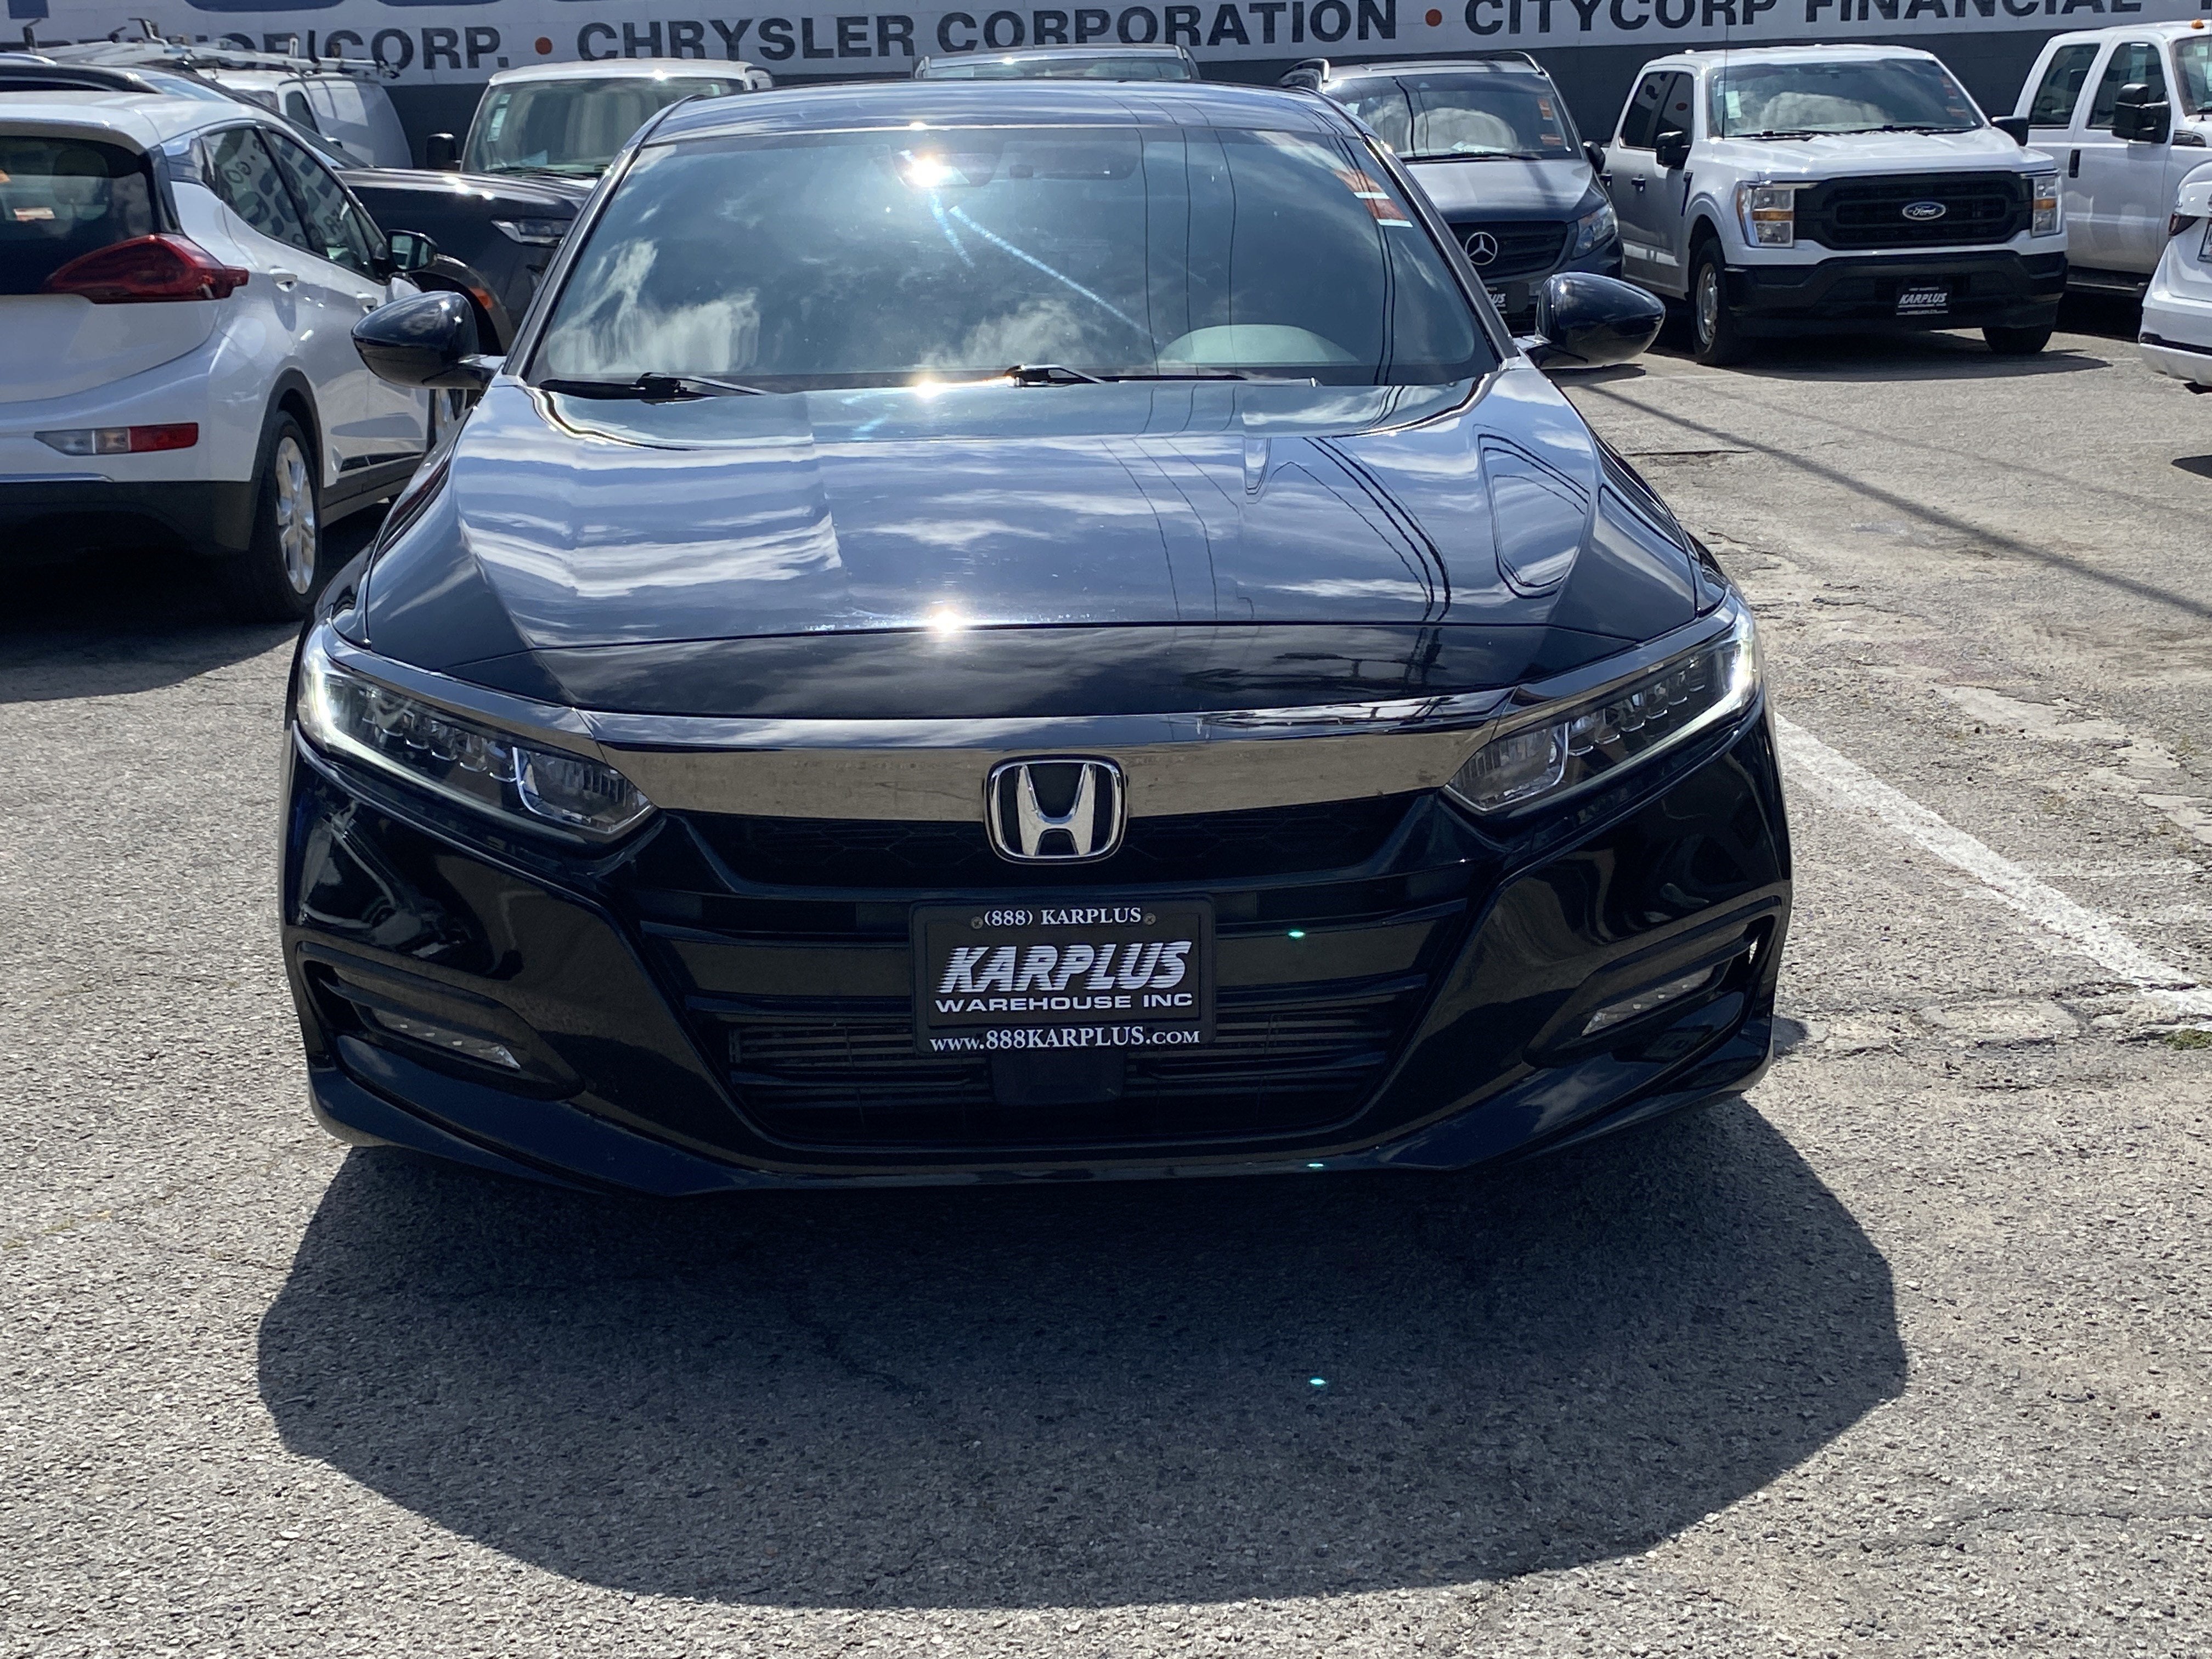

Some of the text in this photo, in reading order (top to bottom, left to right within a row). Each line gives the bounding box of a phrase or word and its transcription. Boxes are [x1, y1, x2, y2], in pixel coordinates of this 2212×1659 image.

[577, 15, 915, 61] CHRYSLER
[937, 0, 1396, 53] CORPORATION
[1465, 0, 1776, 35] CITYCORP
[1899, 292, 1948, 304] KARPLUS
[984, 907, 1142, 927] (888) KARPLUS
[936, 941, 1192, 994] KARPLUS
[935, 992, 1193, 1013] WAREHOUSE INC
